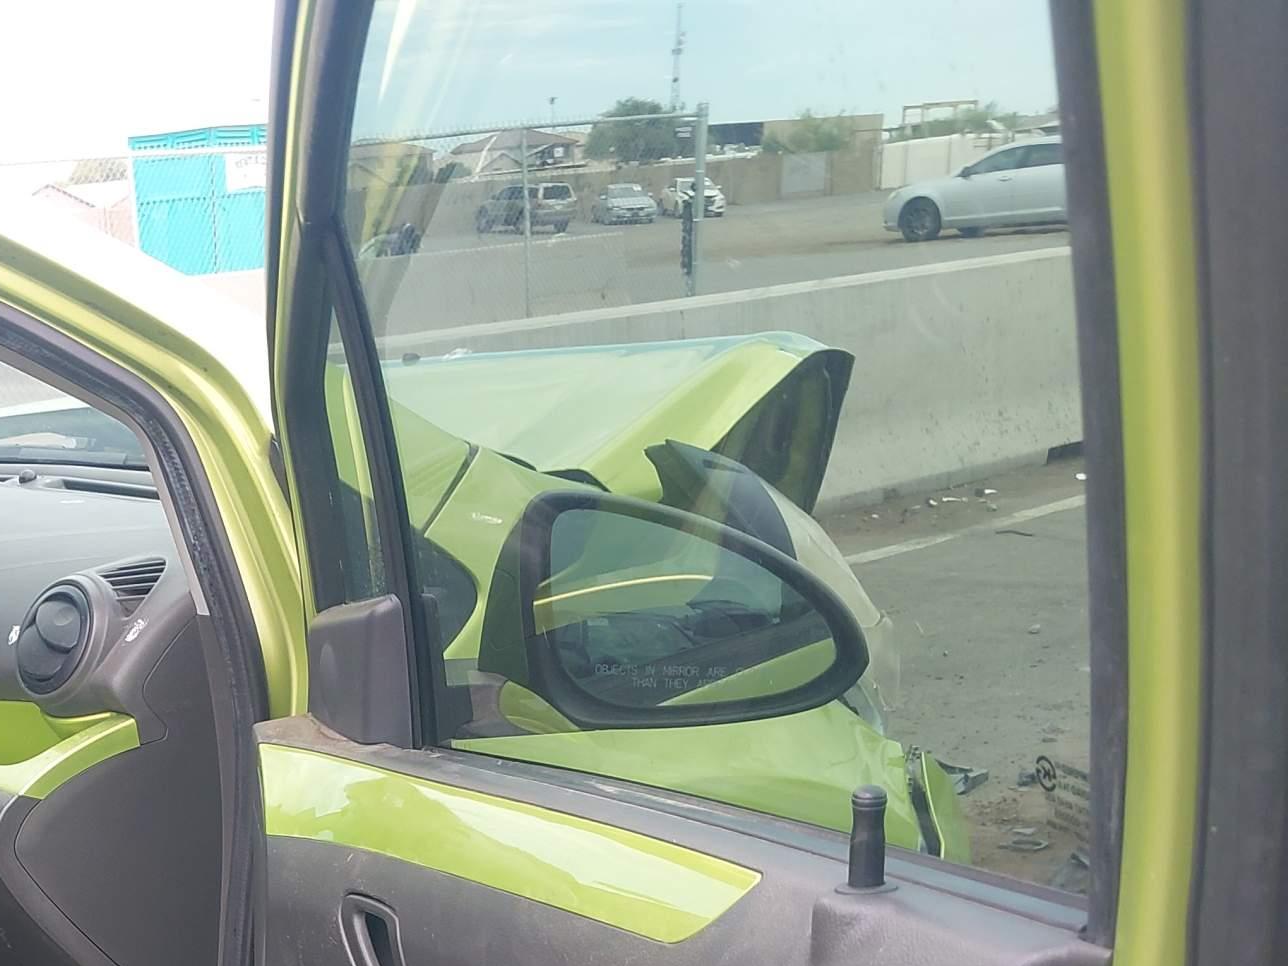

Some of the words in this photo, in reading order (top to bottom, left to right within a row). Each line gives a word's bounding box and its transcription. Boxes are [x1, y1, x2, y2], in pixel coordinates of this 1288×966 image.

[593, 663, 638, 676] OBJECTS
[644, 664, 656, 676] IN
[663, 665, 701, 677] MIRROR
[706, 667, 727, 678] ARE
[631, 677, 657, 688] THAN
[665, 678, 689, 689] THEY
